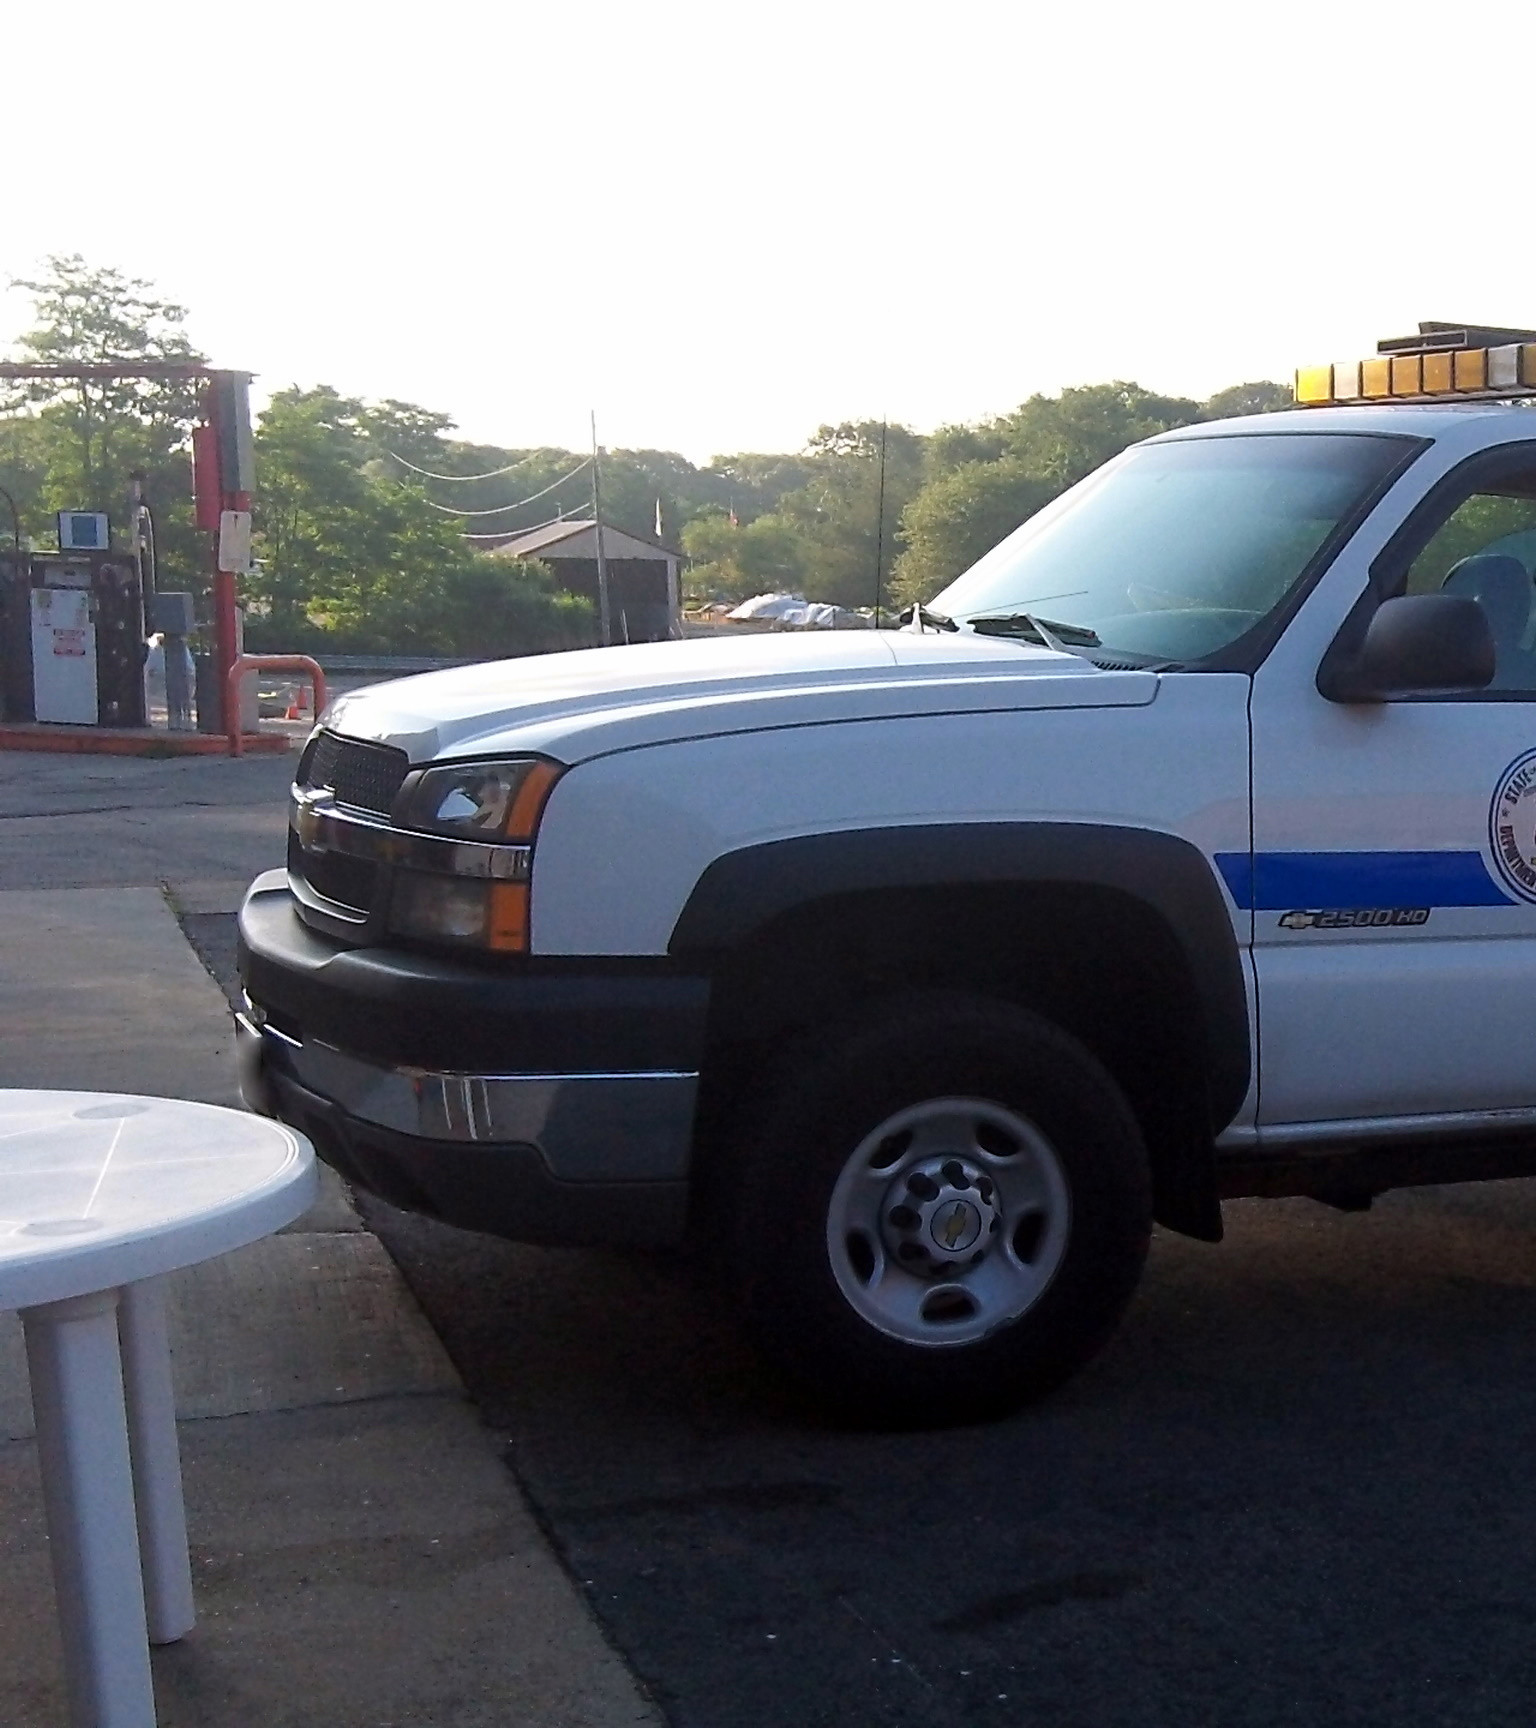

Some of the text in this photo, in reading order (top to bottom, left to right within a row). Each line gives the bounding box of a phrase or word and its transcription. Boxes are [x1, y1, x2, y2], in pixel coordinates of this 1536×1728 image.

[1504, 768, 1532, 804] STATE
[1319, 908, 1428, 927] 2500 HD
